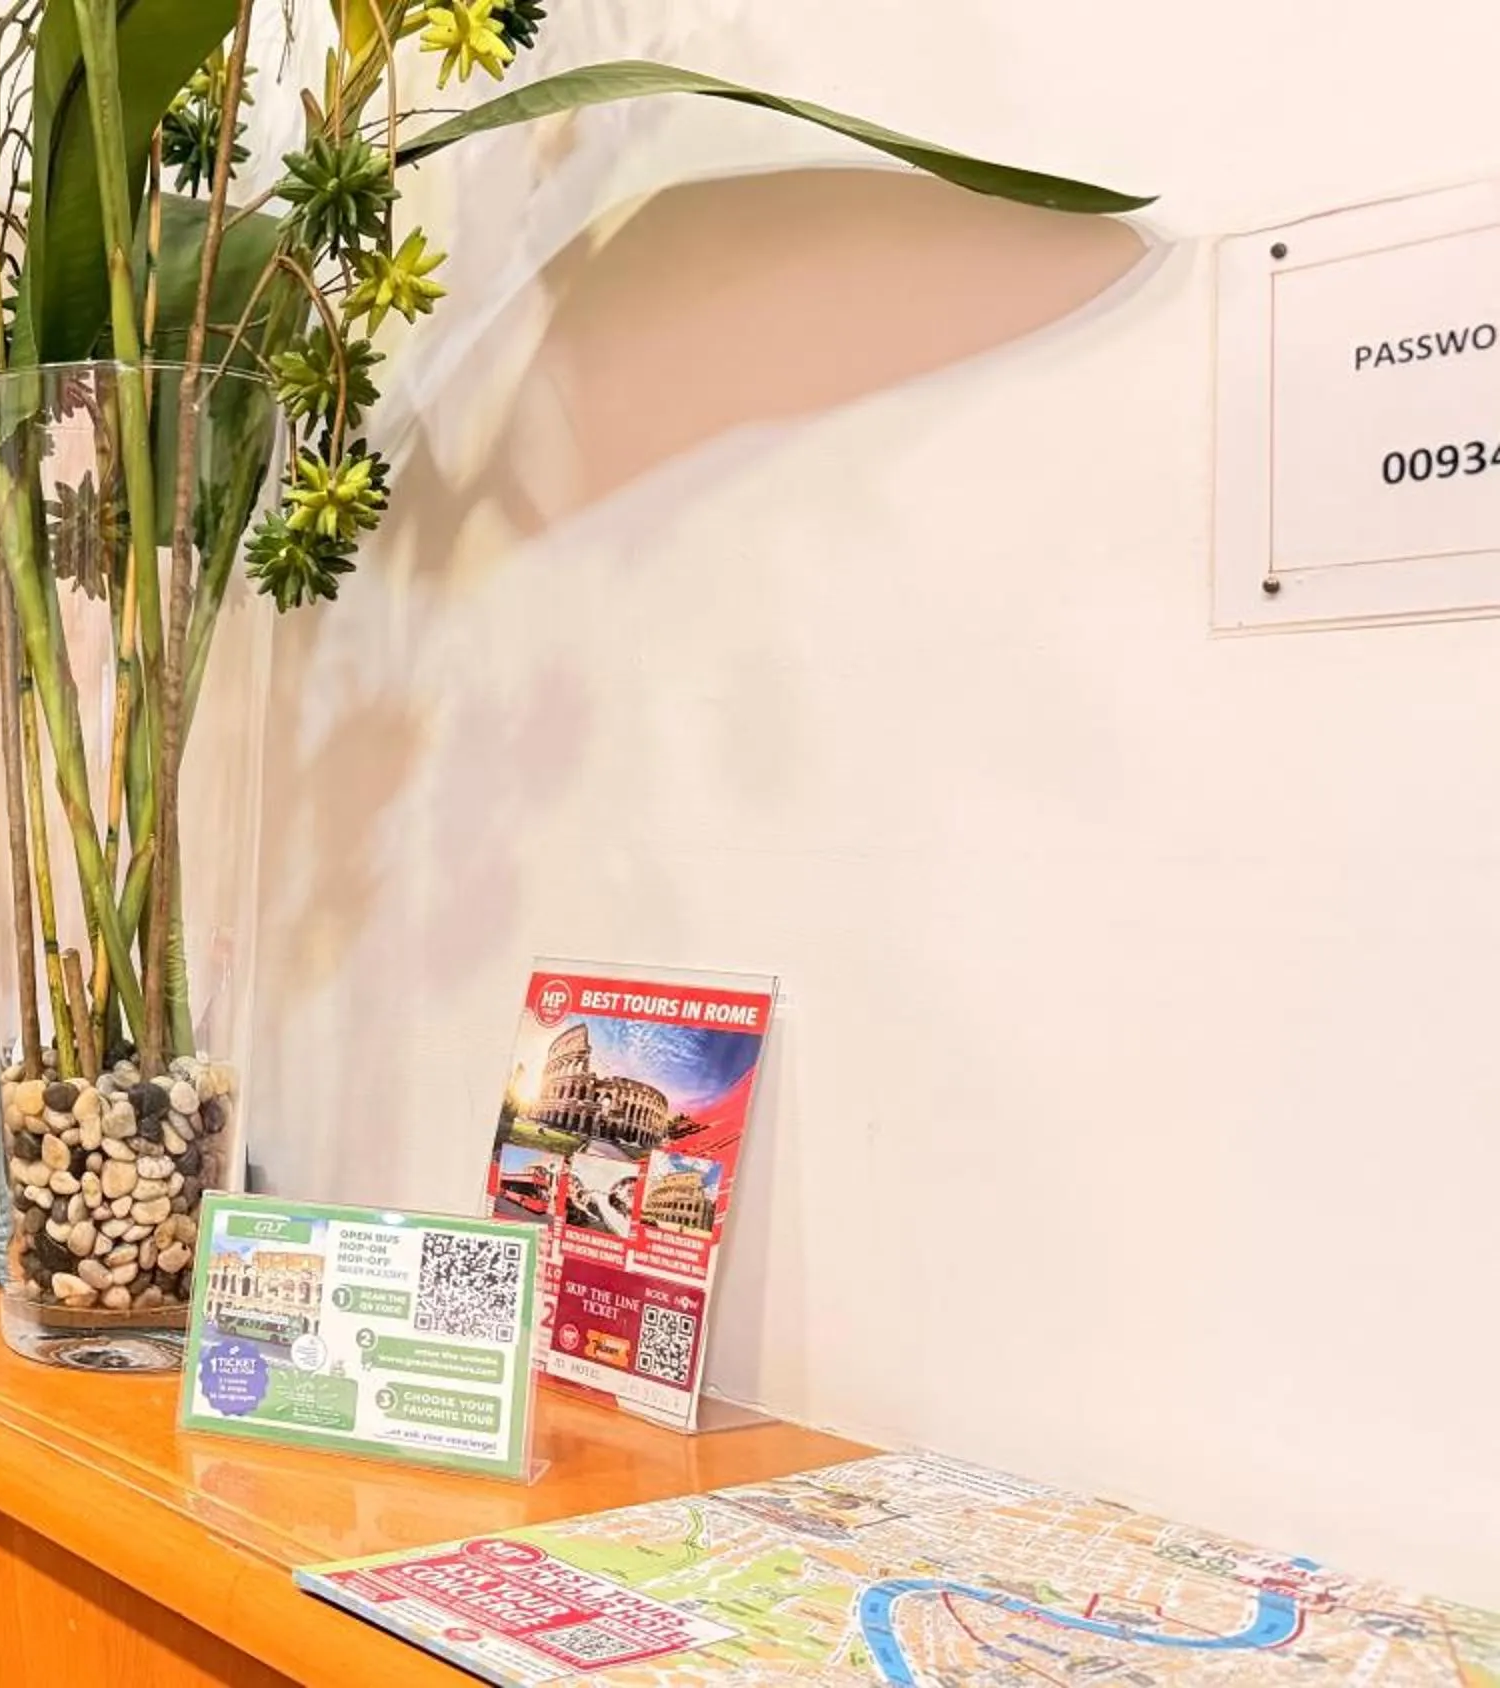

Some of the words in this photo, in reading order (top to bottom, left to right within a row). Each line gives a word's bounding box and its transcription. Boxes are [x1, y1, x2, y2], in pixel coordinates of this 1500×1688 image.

[580, 990, 622, 1010] BEST
[623, 994, 677, 1017] TOURS
[682, 1002, 702, 1020] IN
[704, 1004, 759, 1025] ROME
[339, 1241, 387, 1254] HOP-ON
[340, 1229, 373, 1241] OPEN
[375, 1233, 400, 1244] BUS
[565, 1281, 588, 1297] SKIP
[590, 1287, 611, 1304] THE
[615, 1294, 640, 1312] LINE
[582, 1299, 620, 1319] TICKET
[218, 1357, 257, 1369] TICKET
[403, 1391, 456, 1407] CHOOSE
[459, 1399, 496, 1413] YOUR
[402, 1403, 460, 1421] FAVORITE
[461, 1413, 495, 1426] TOUR
[401, 1564, 551, 1627] CONCIERGE
[434, 1562, 500, 1589] ASK
[487, 1582, 570, 1618] YOUR
[536, 1562, 604, 1589] BEST
[603, 1589, 693, 1628] TOURS
